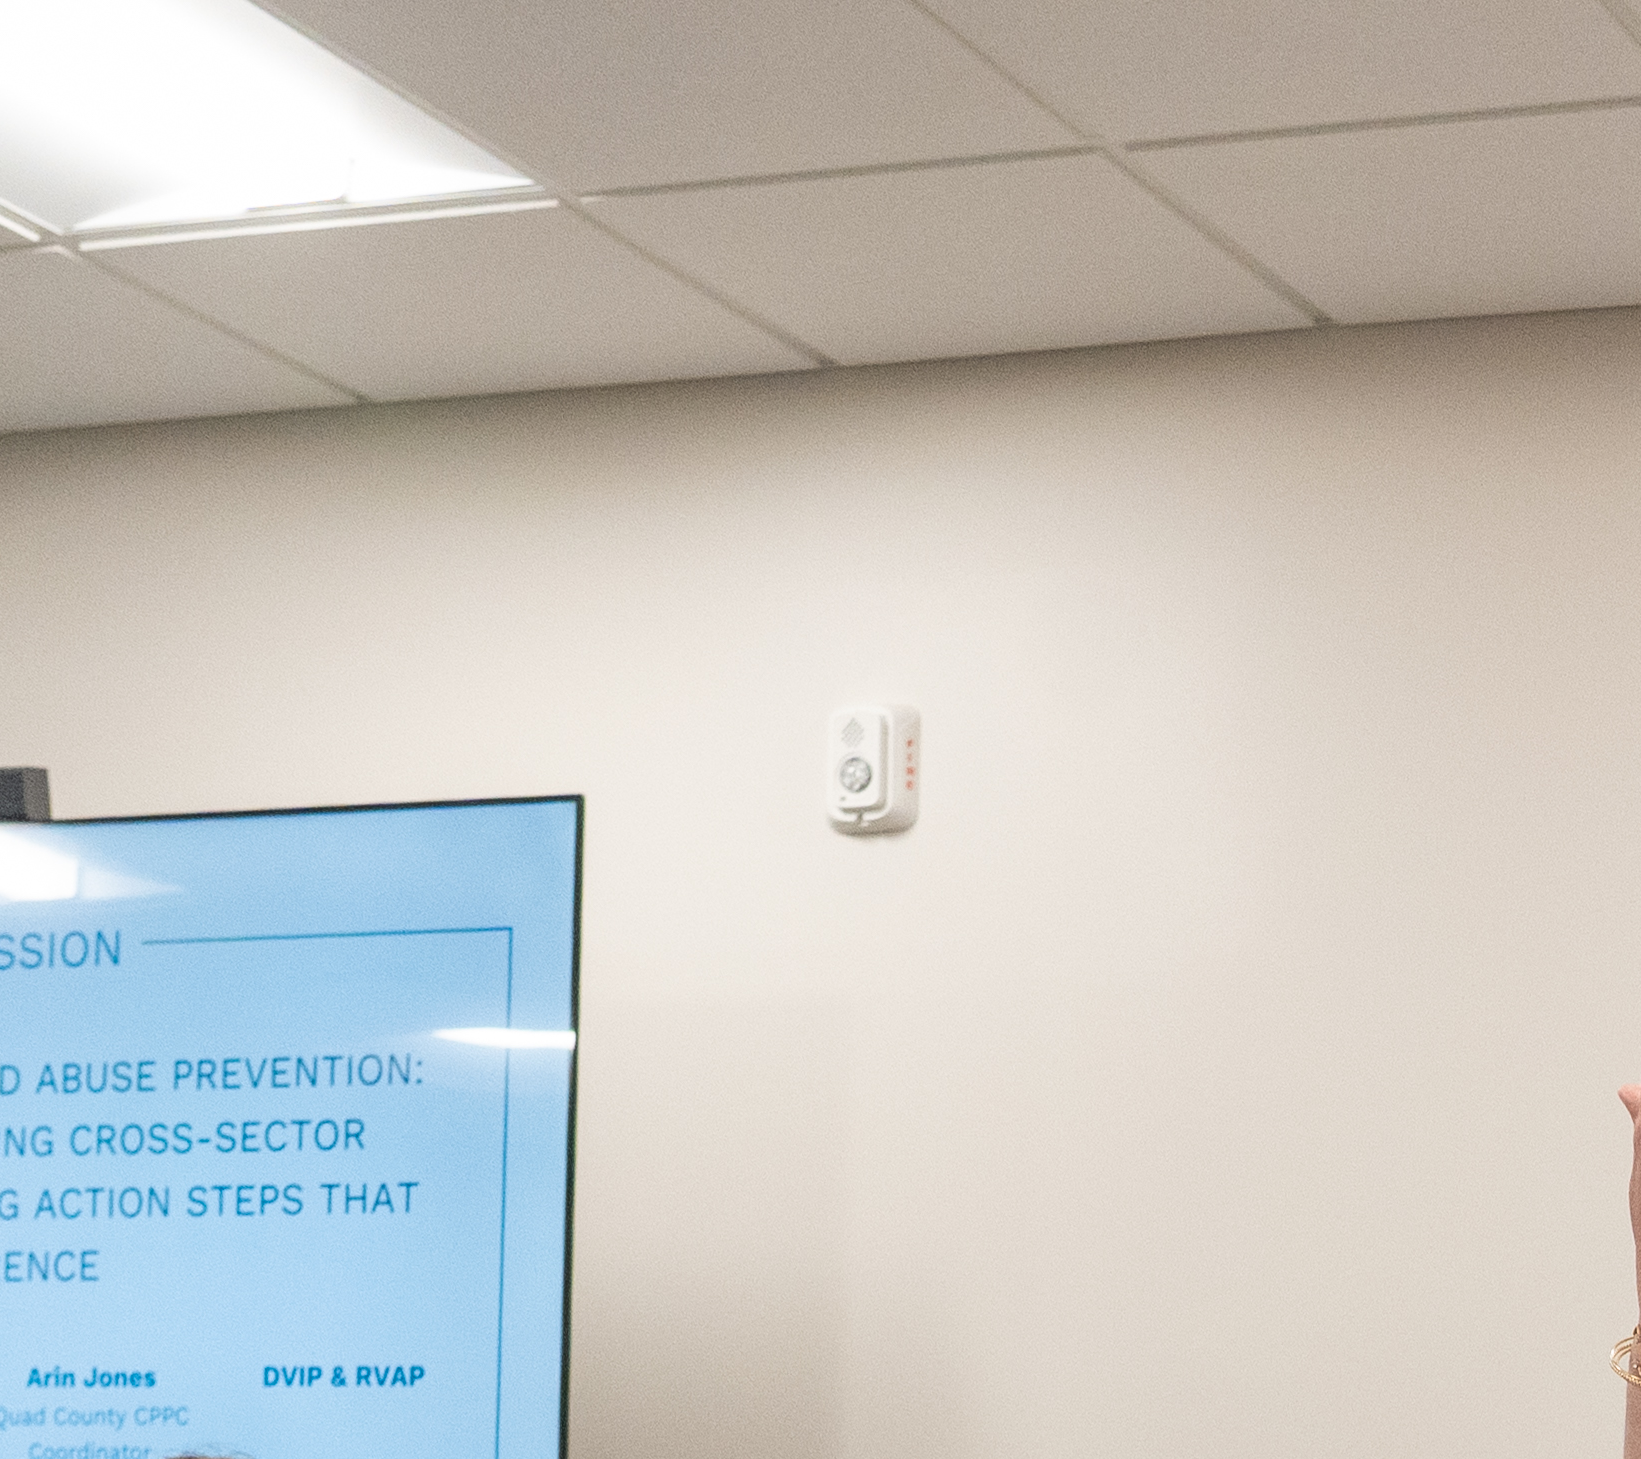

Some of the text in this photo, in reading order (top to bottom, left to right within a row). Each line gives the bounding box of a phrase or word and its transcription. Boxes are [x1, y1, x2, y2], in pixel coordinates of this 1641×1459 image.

[36, 1059, 157, 1095] ABUSE
[172, 1053, 424, 1091] PREVENTION:
[69, 1118, 366, 1157] CROSS-SECTOR
[33, 1185, 171, 1221] ACTION
[186, 1182, 304, 1219] STEPS
[319, 1181, 420, 1216] THAT
[26, 1366, 157, 1390] Arin Jones
[262, 1365, 426, 1389] DVIP & RVAP
[54, 1406, 127, 1431] County
[134, 1405, 190, 1427] CPPC
